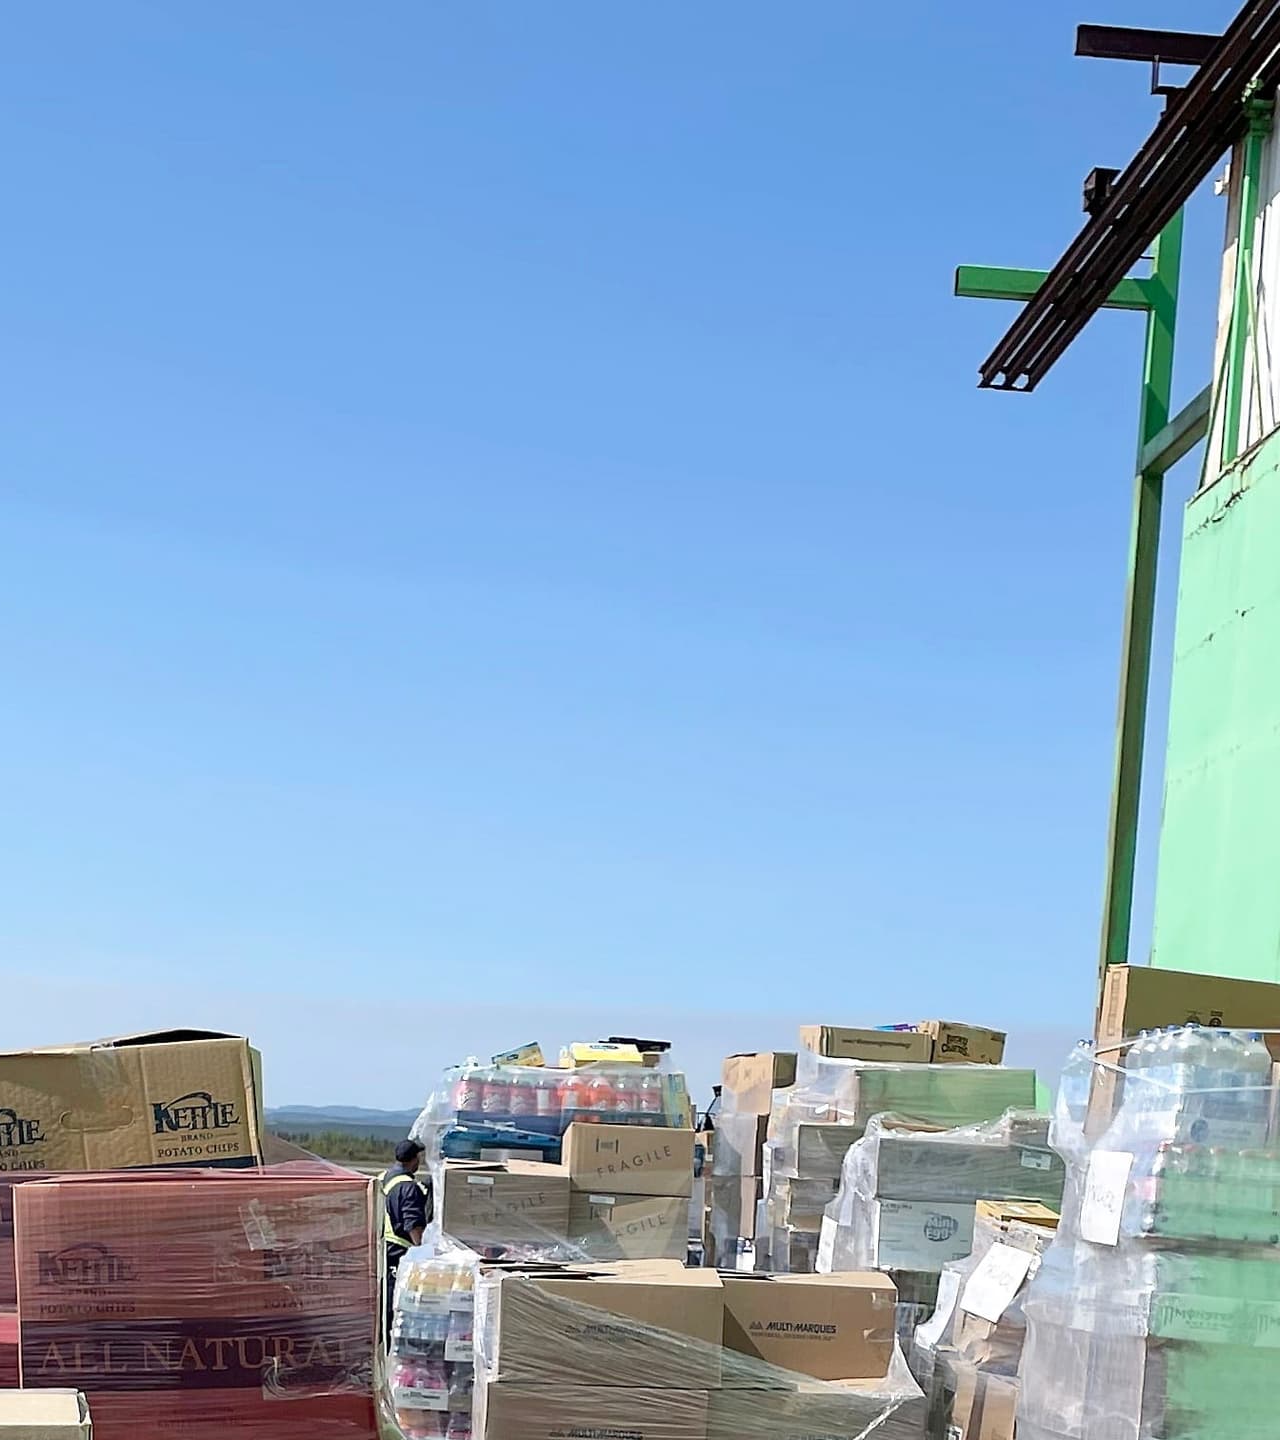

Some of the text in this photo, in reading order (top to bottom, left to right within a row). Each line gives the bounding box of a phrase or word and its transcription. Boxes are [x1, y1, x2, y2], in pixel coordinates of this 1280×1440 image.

[181, 1133, 214, 1142] BRAND
[158, 1142, 240, 1158] POTATO CHIPS
[597, 1145, 671, 1179] FRAGILE
[767, 1322, 837, 1334] MULTI-MARQUES
[37, 1340, 127, 1374] ALL
